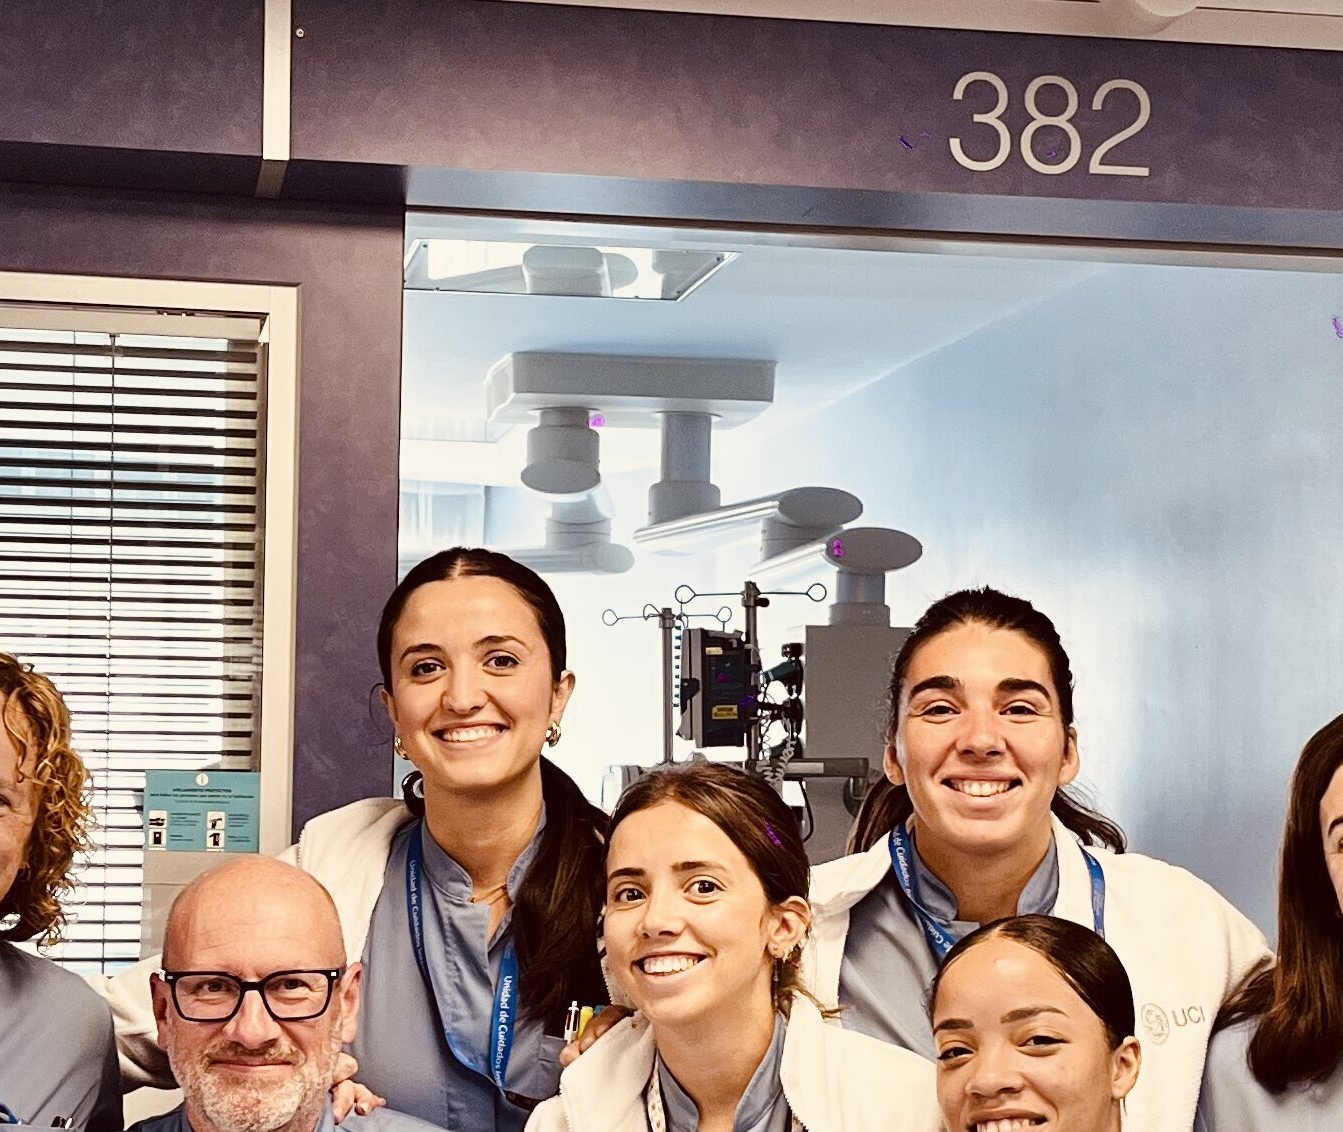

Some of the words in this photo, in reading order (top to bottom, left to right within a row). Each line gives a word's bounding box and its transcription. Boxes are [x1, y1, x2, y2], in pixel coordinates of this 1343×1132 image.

[949, 71, 1151, 177] 382
[500, 975, 513, 1009] Unidad
[498, 1010, 510, 1023] de
[1171, 1006, 1206, 1027] UCI
[495, 1024, 509, 1071] Cuidados
